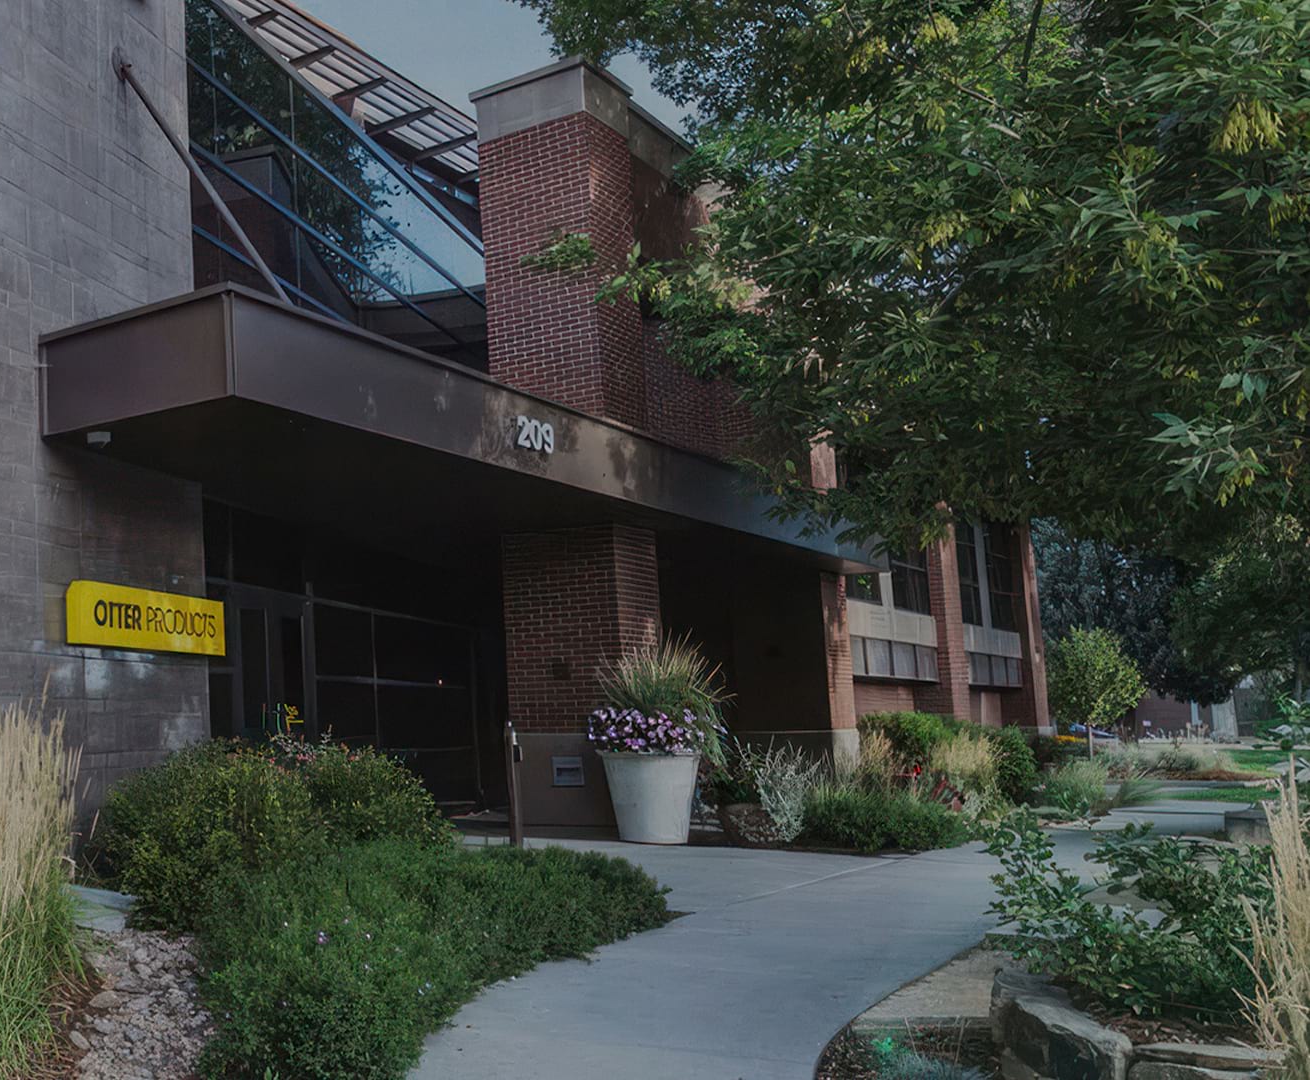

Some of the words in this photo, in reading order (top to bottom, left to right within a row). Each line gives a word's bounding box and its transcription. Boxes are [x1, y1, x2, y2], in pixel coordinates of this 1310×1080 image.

[516, 414, 555, 454] 209
[94, 600, 142, 631] OTTER
[146, 606, 216, 639] PRODUCTS
